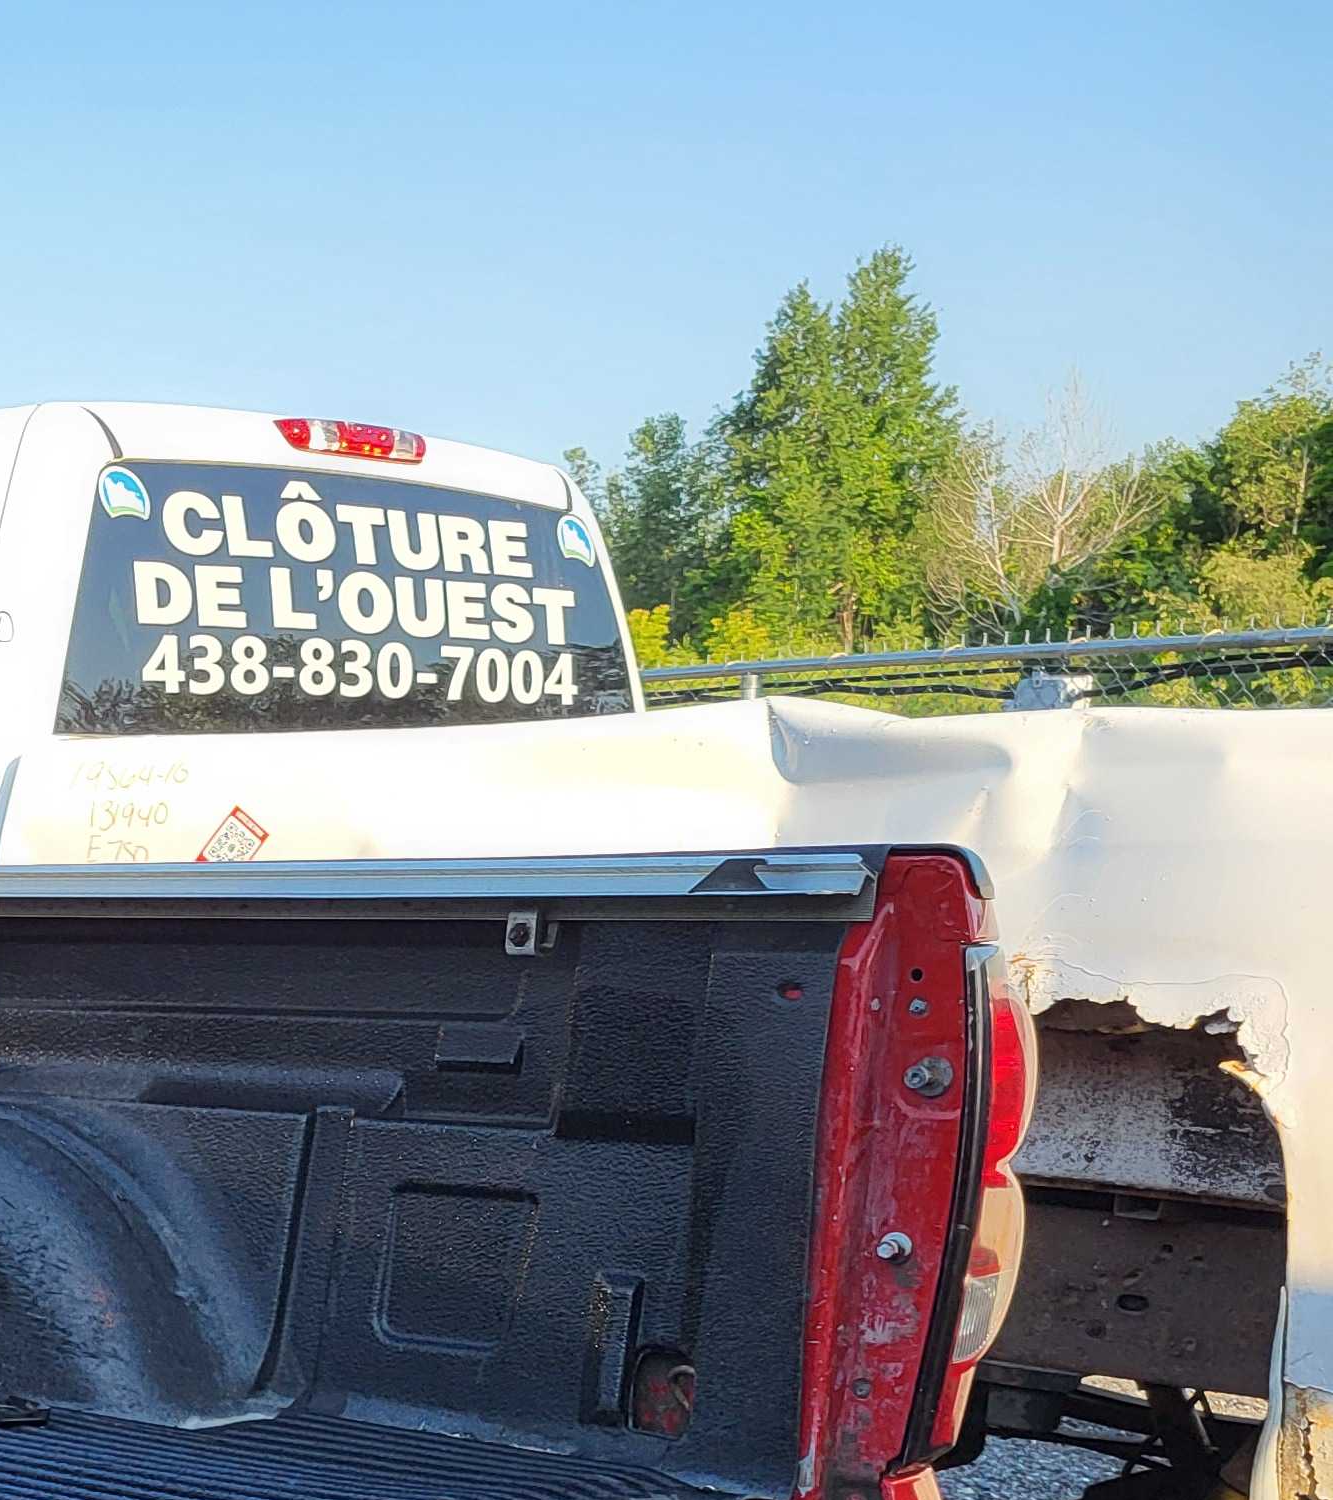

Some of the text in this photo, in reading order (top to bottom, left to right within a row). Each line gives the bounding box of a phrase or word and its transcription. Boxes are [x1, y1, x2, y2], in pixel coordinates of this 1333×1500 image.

[161, 481, 534, 578] CLÔTURE
[133, 560, 576, 647] DE L'OUEST
[140, 632, 579, 706] 438-830-7004
